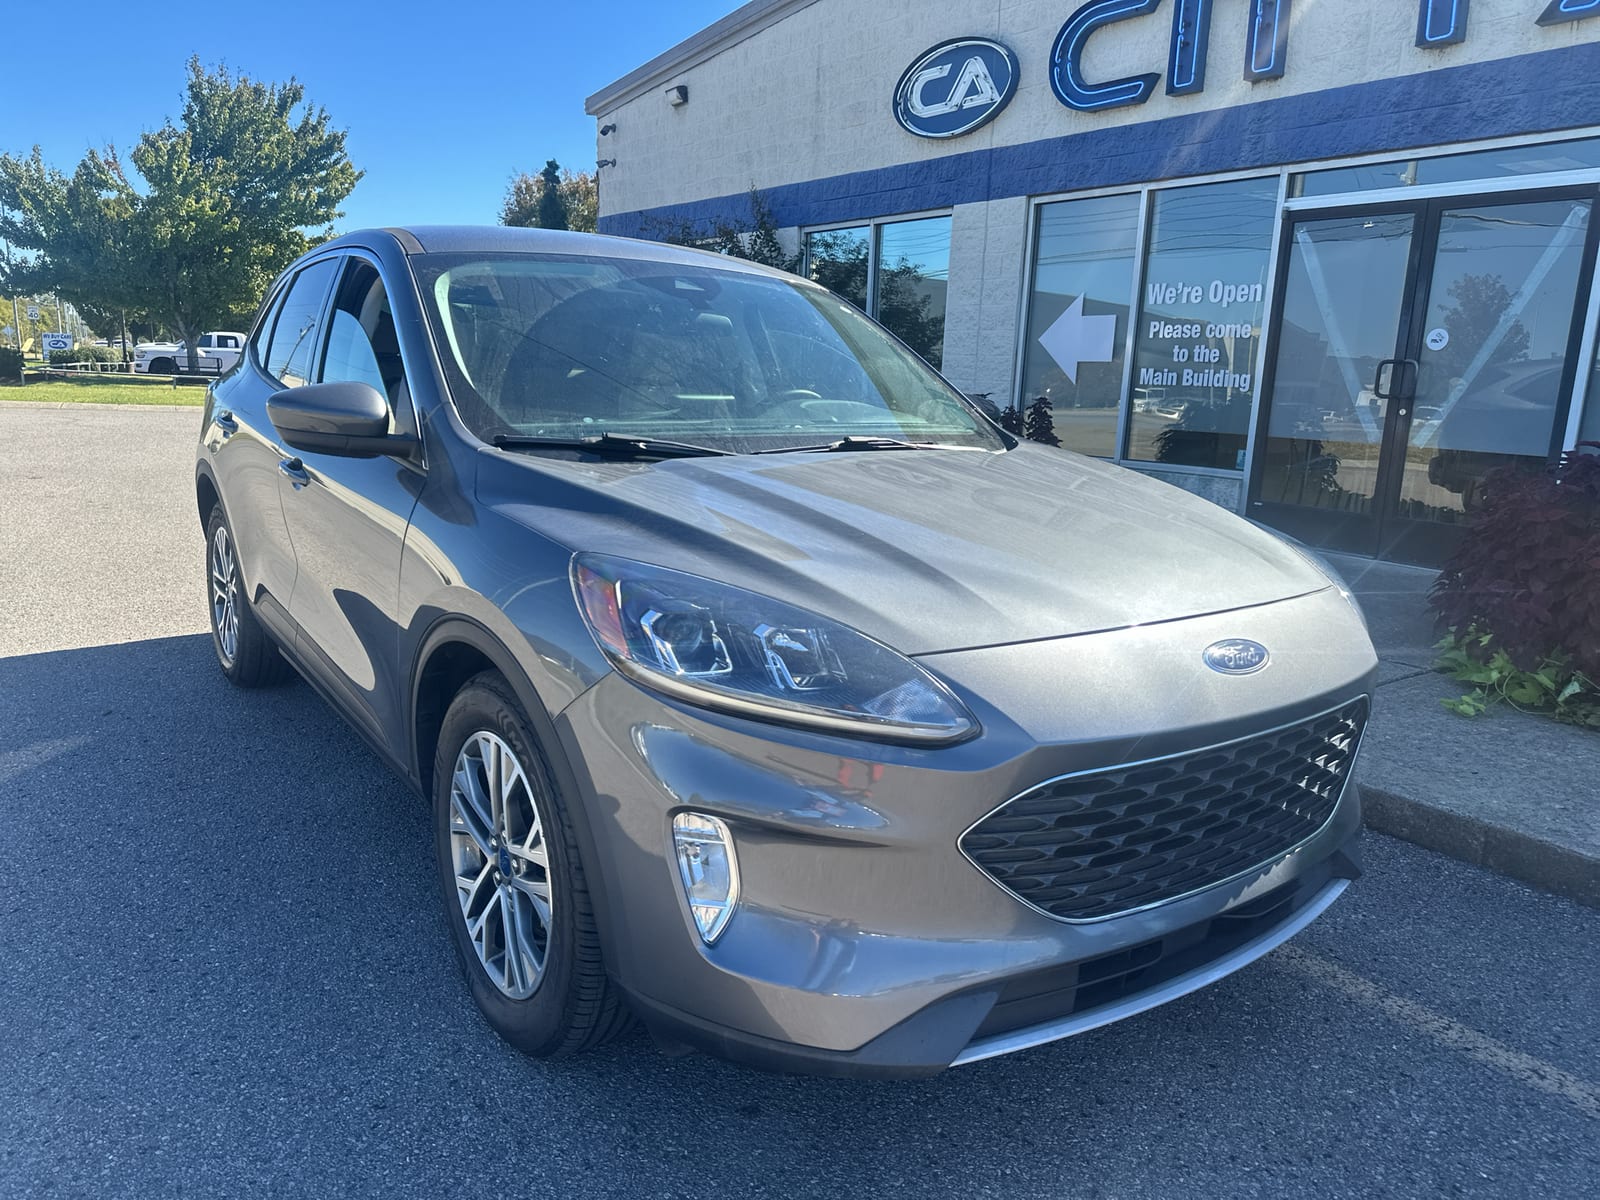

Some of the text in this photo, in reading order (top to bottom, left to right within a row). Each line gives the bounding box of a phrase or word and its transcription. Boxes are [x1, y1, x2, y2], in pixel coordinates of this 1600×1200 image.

[907, 55, 1001, 118] CA
[1148, 280, 1263, 307] We're Open
[1149, 320, 1252, 339] Please come
[1173, 344, 1220, 363] to the
[1139, 368, 1251, 392] Main Building
[1211, 643, 1261, 669] Ford
